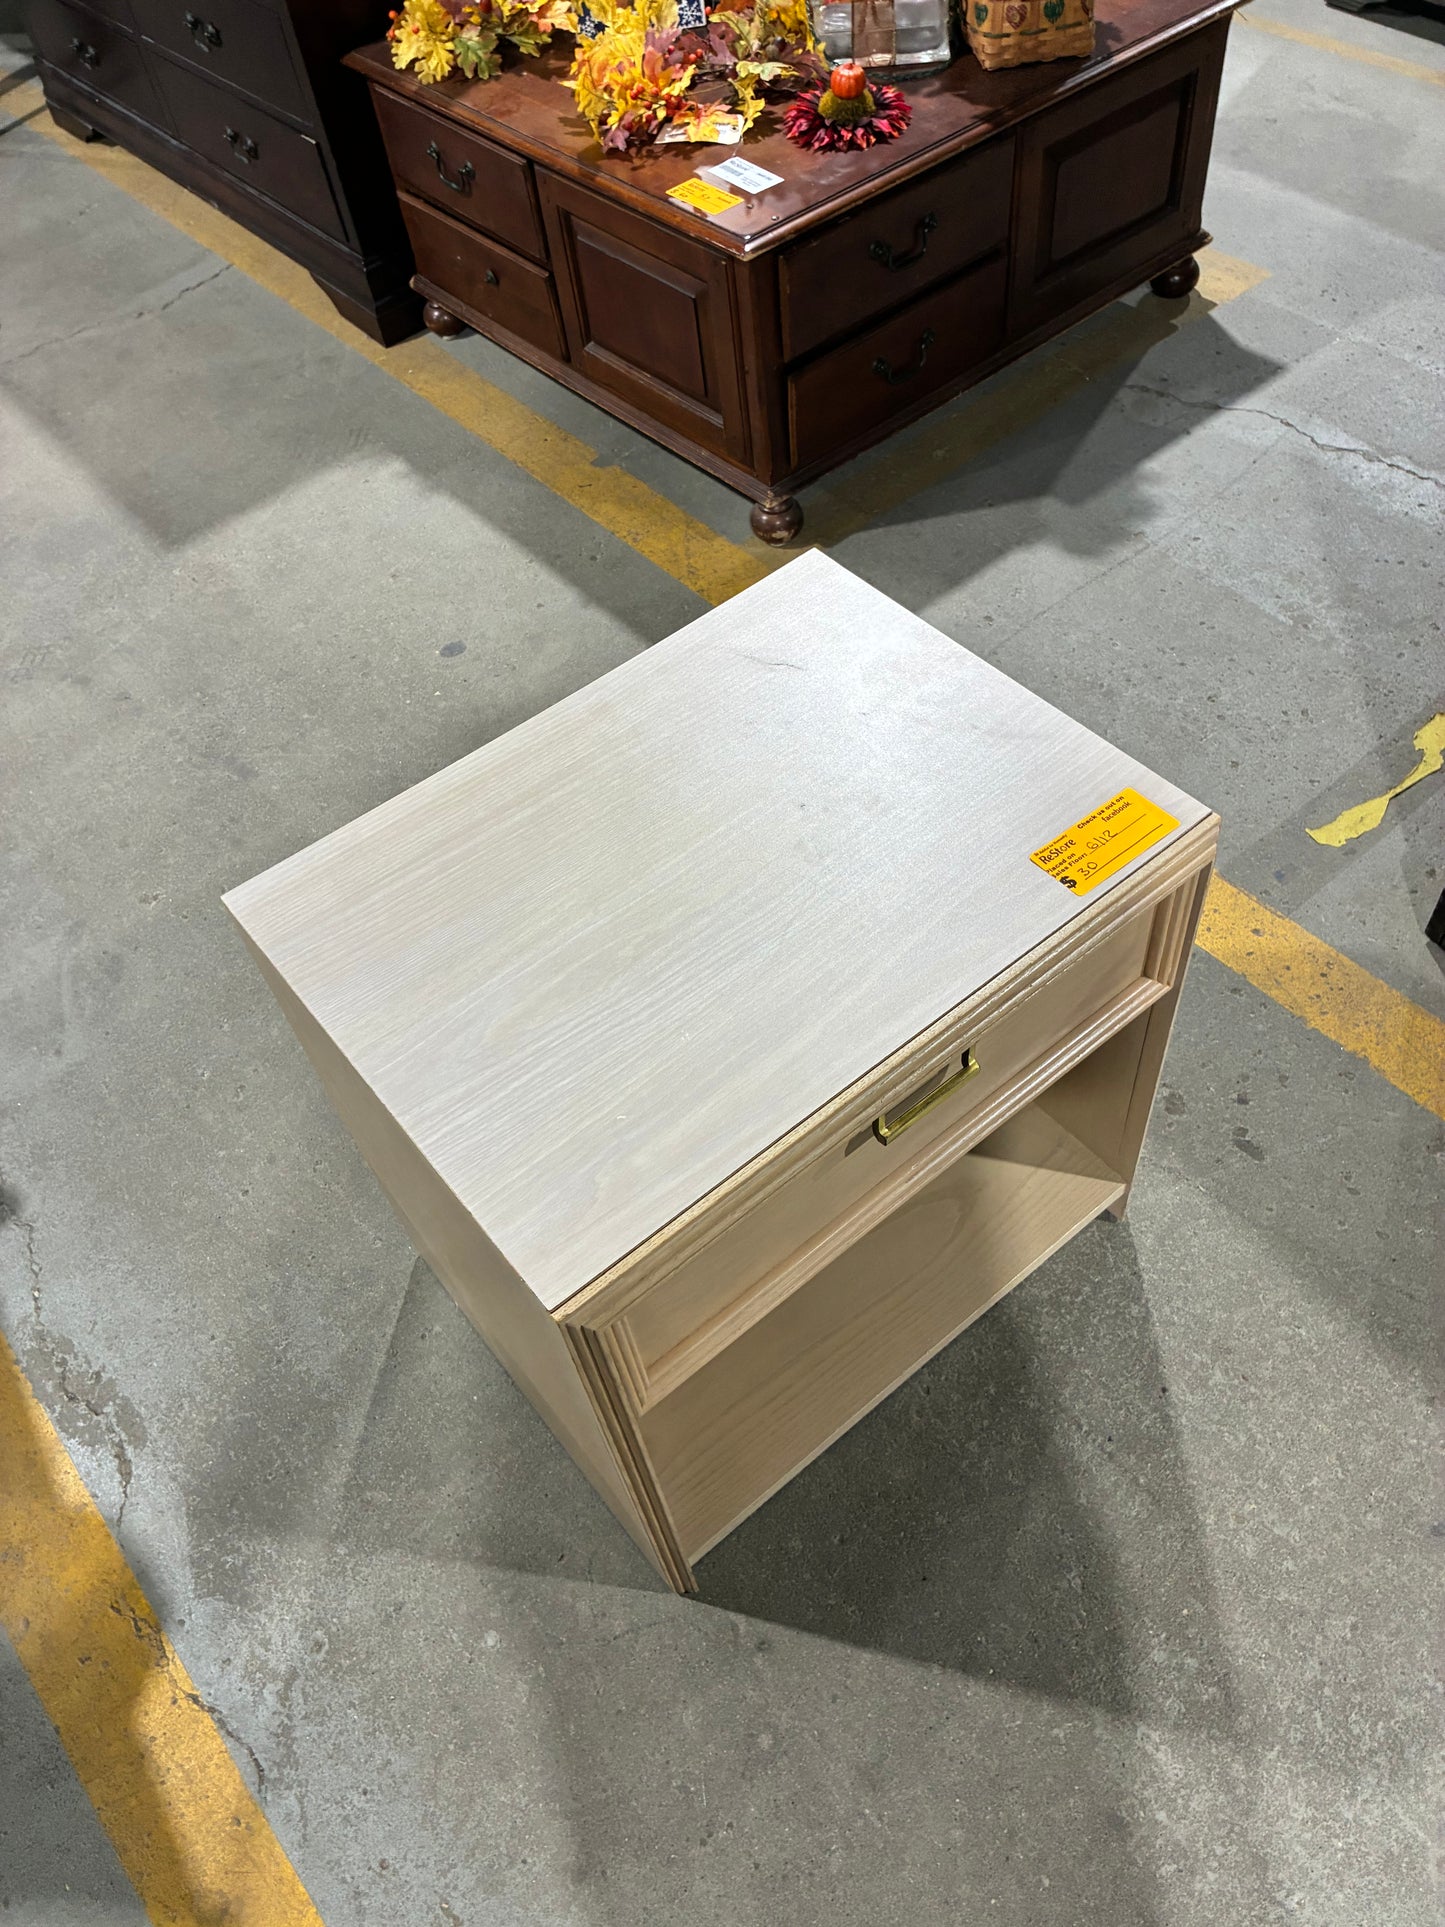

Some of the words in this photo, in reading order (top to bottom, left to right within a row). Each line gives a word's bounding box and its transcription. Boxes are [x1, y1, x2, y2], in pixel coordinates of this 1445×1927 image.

[1077, 815, 1097, 829] Check
[1105, 801, 1116, 810] out
[1101, 801, 1131, 822] facebook
[1039, 839, 1076, 864] ReStore
[1059, 876, 1077, 889] $
[1077, 862, 1098, 877] 30
